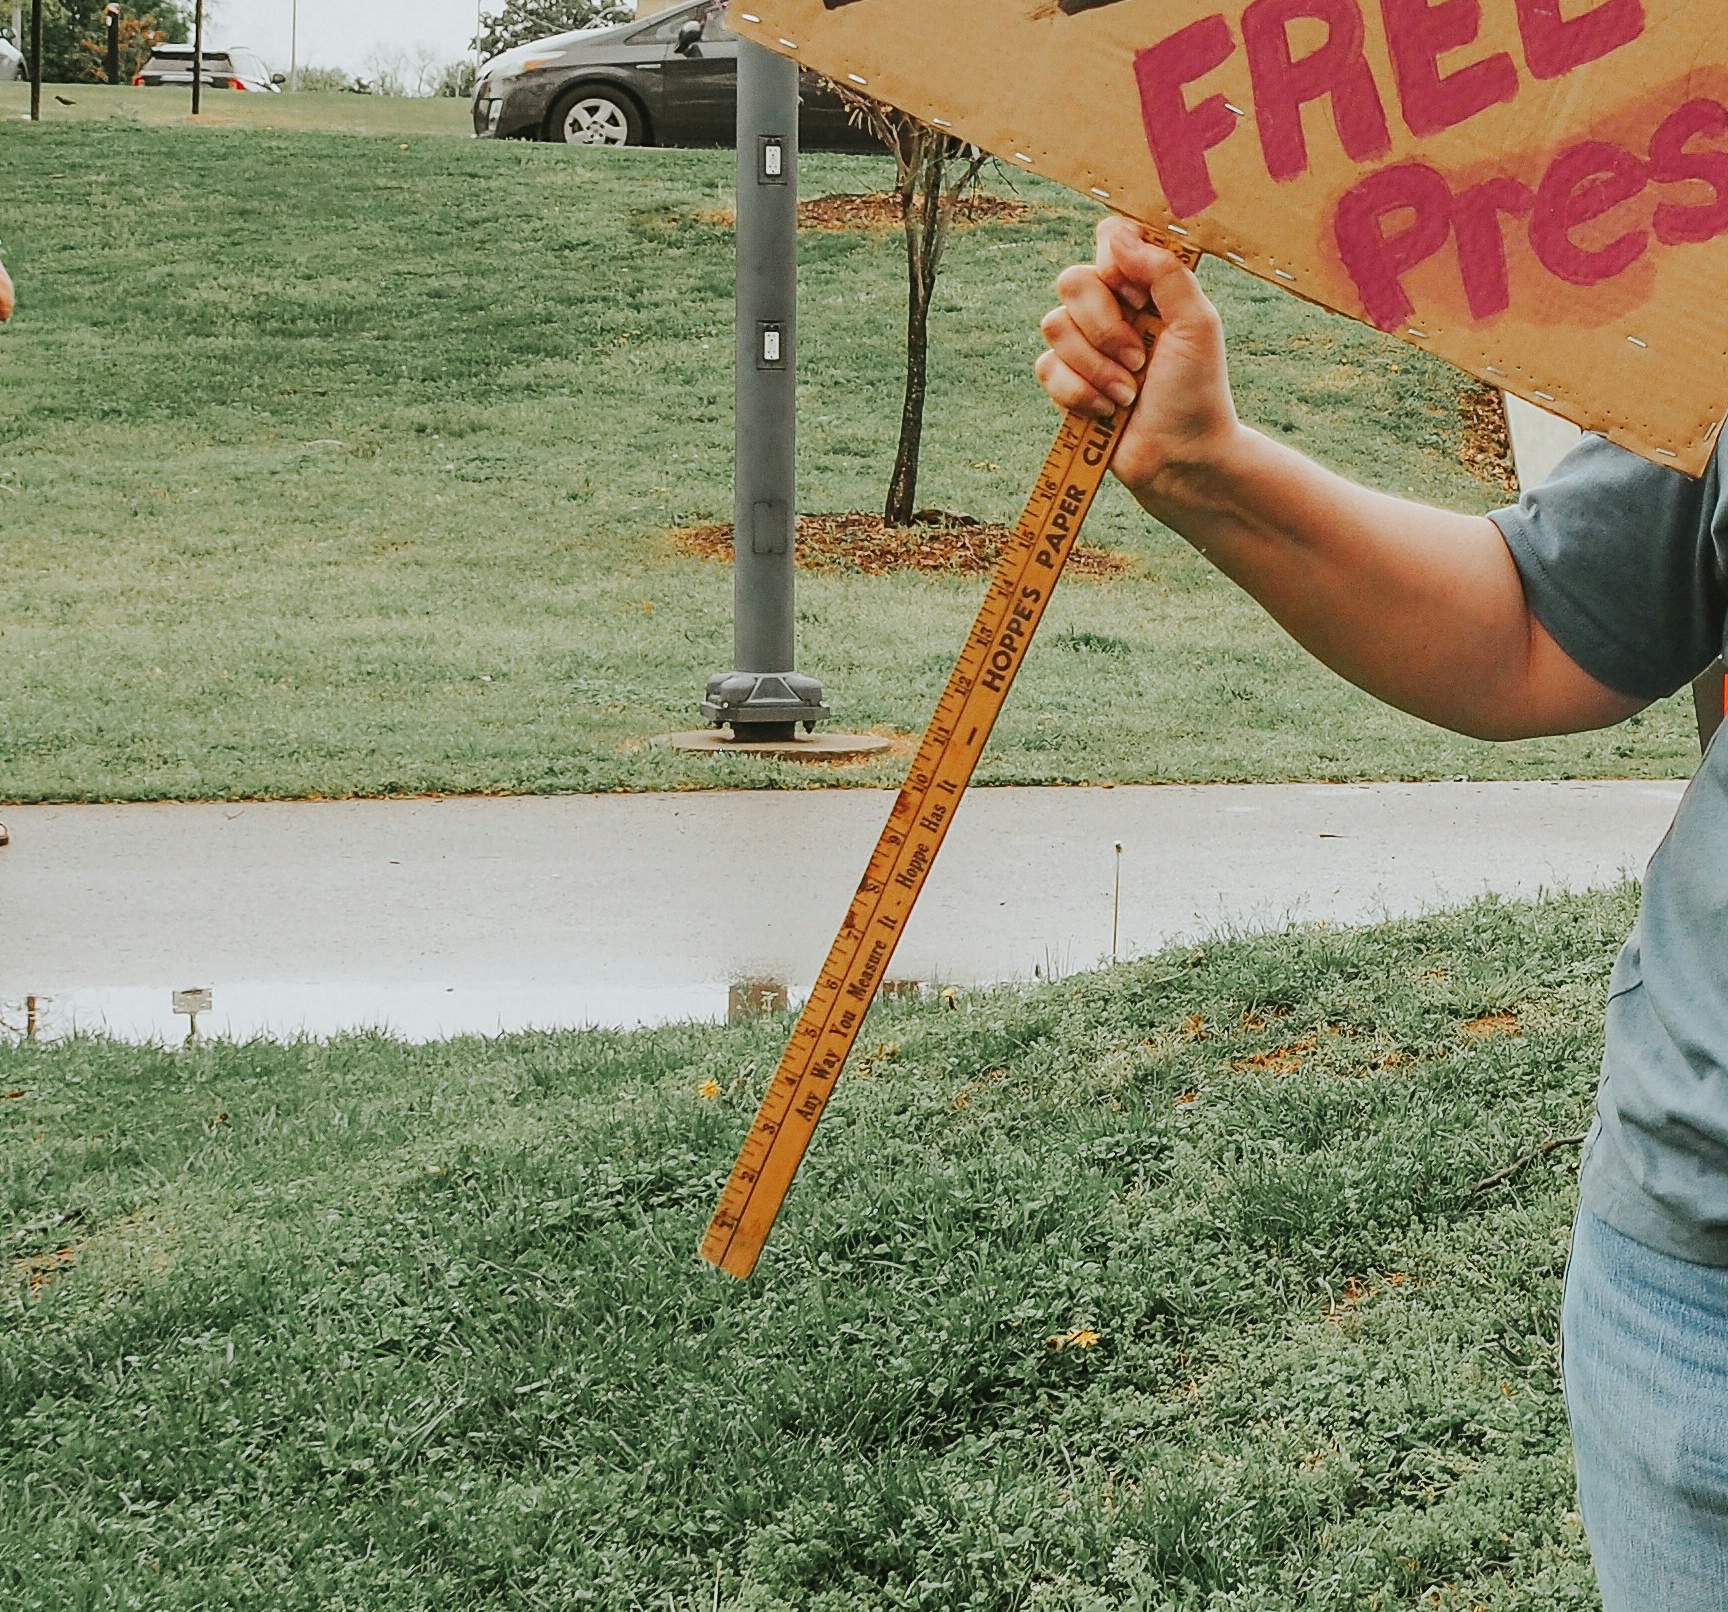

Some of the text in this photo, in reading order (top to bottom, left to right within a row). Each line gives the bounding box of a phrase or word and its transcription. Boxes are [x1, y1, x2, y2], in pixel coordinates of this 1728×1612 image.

[981, 585, 1041, 693] HOPPE'S
[1034, 484, 1088, 570] PAPER
[738, 1170, 756, 1184] 2
[760, 1123, 776, 1135] 3
[784, 1075, 798, 1087] 4
[803, 1027, 818, 1039] 5
[825, 978, 839, 991] 6
[845, 927, 863, 941] 7
[865, 882, 881, 895] 8
[887, 834, 902, 846] 9
[911, 773, 929, 794] 10
[932, 726, 951, 747] 11
[954, 675, 972, 697] 12
[975, 626, 993, 648] 13
[997, 578, 1015, 600] 14
[1018, 528, 1036, 551] 15
[1039, 479, 1058, 502] 16
[1061, 429, 1080, 452] 17
[794, 1090, 824, 1123] Any
[809, 1049, 842, 1080] Way
[828, 1009, 857, 1039] You
[845, 939, 887, 1002] Measure
[876, 915, 898, 932] It
[894, 843, 930, 890] Hoppe
[919, 803, 947, 834] Has
[935, 779, 959, 796] It
